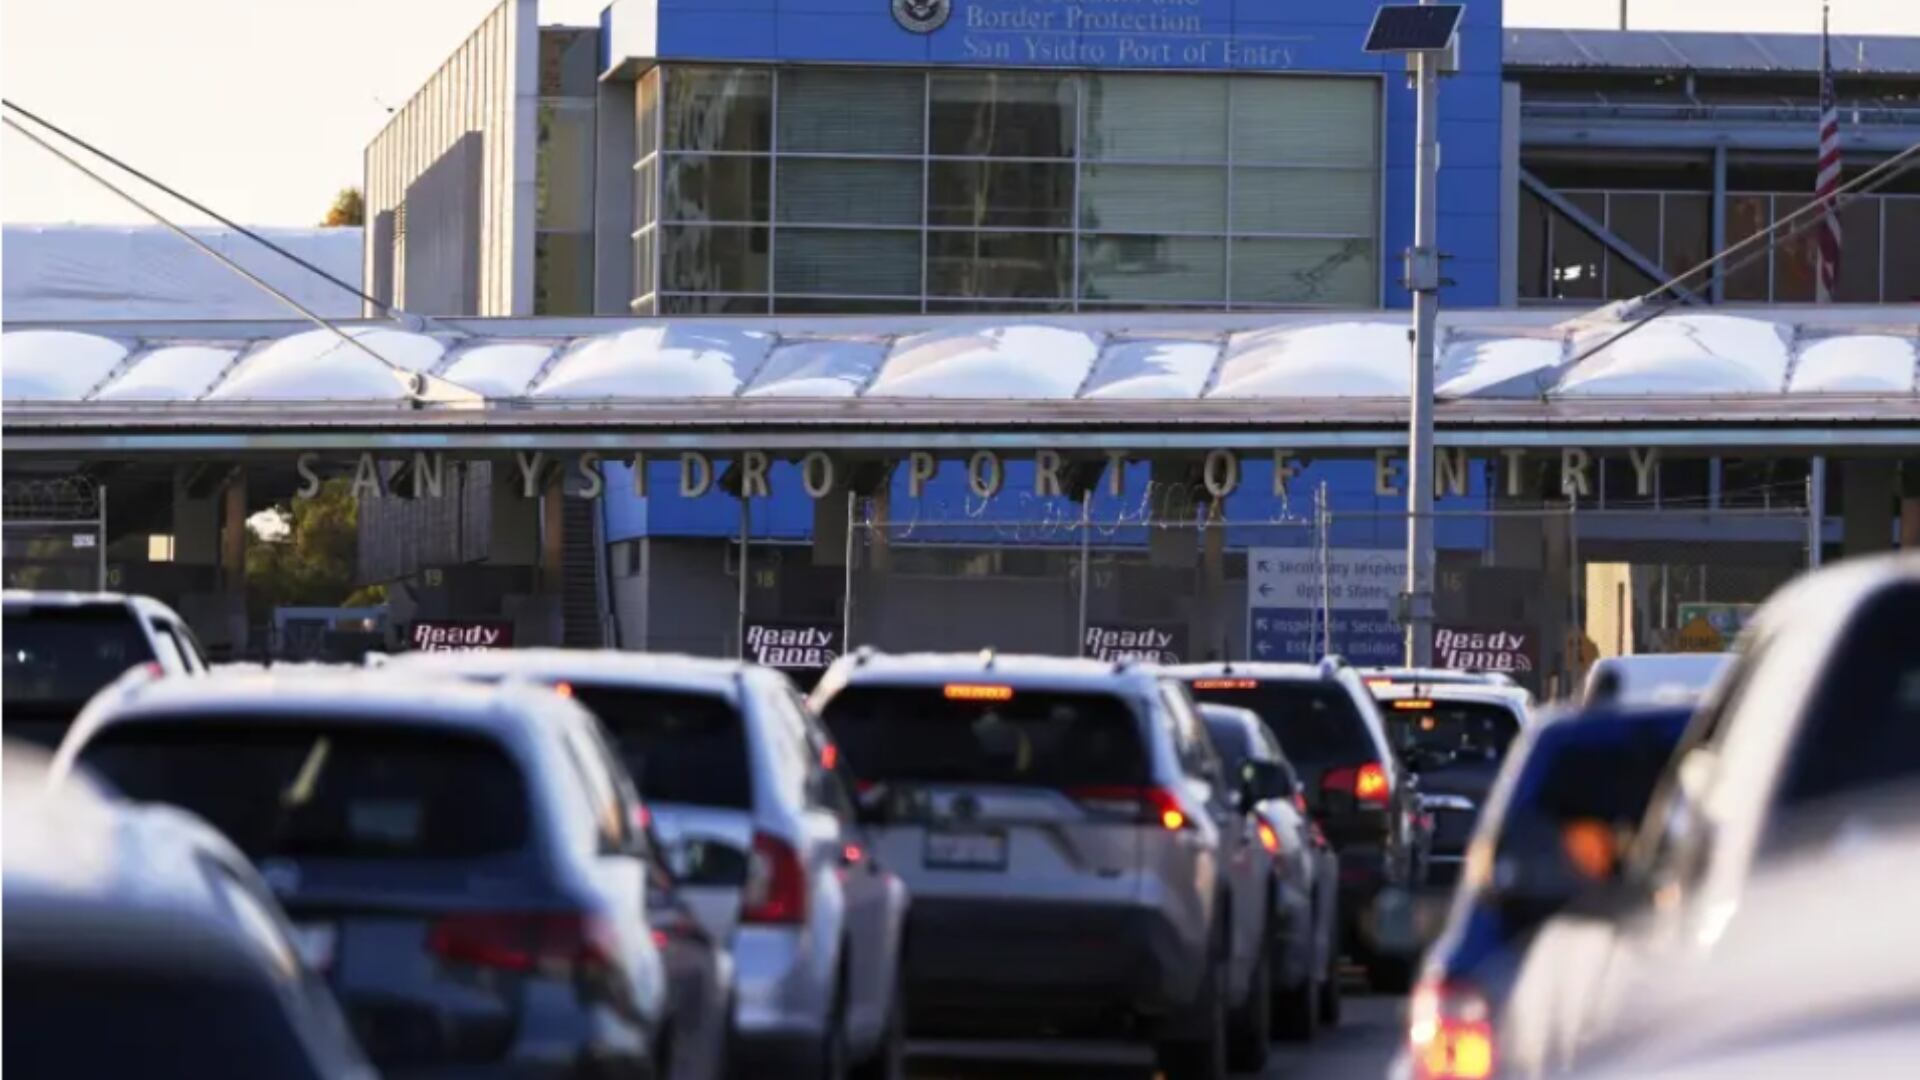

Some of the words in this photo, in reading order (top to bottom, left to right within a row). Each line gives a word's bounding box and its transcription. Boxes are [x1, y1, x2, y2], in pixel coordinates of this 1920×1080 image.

[966, 4, 1055, 30] Border
[1067, 5, 1201, 32] Protection
[963, 35, 1011, 59] San
[1024, 36, 1106, 63] Ysidro
[1118, 38, 1171, 63] Port
[1183, 40, 1213, 64] of
[1223, 40, 1295, 68] Entry
[297, 451, 443, 500] SAN
[517, 451, 834, 500] YSIDRO
[908, 450, 1131, 499] PORT
[1203, 448, 1299, 498] OF
[1374, 448, 1657, 496] ENTRY
[415, 624, 499, 651] Ready
[747, 625, 833, 653] Ready
[1086, 627, 1173, 655] Ready
[1435, 629, 1525, 657] Ready
